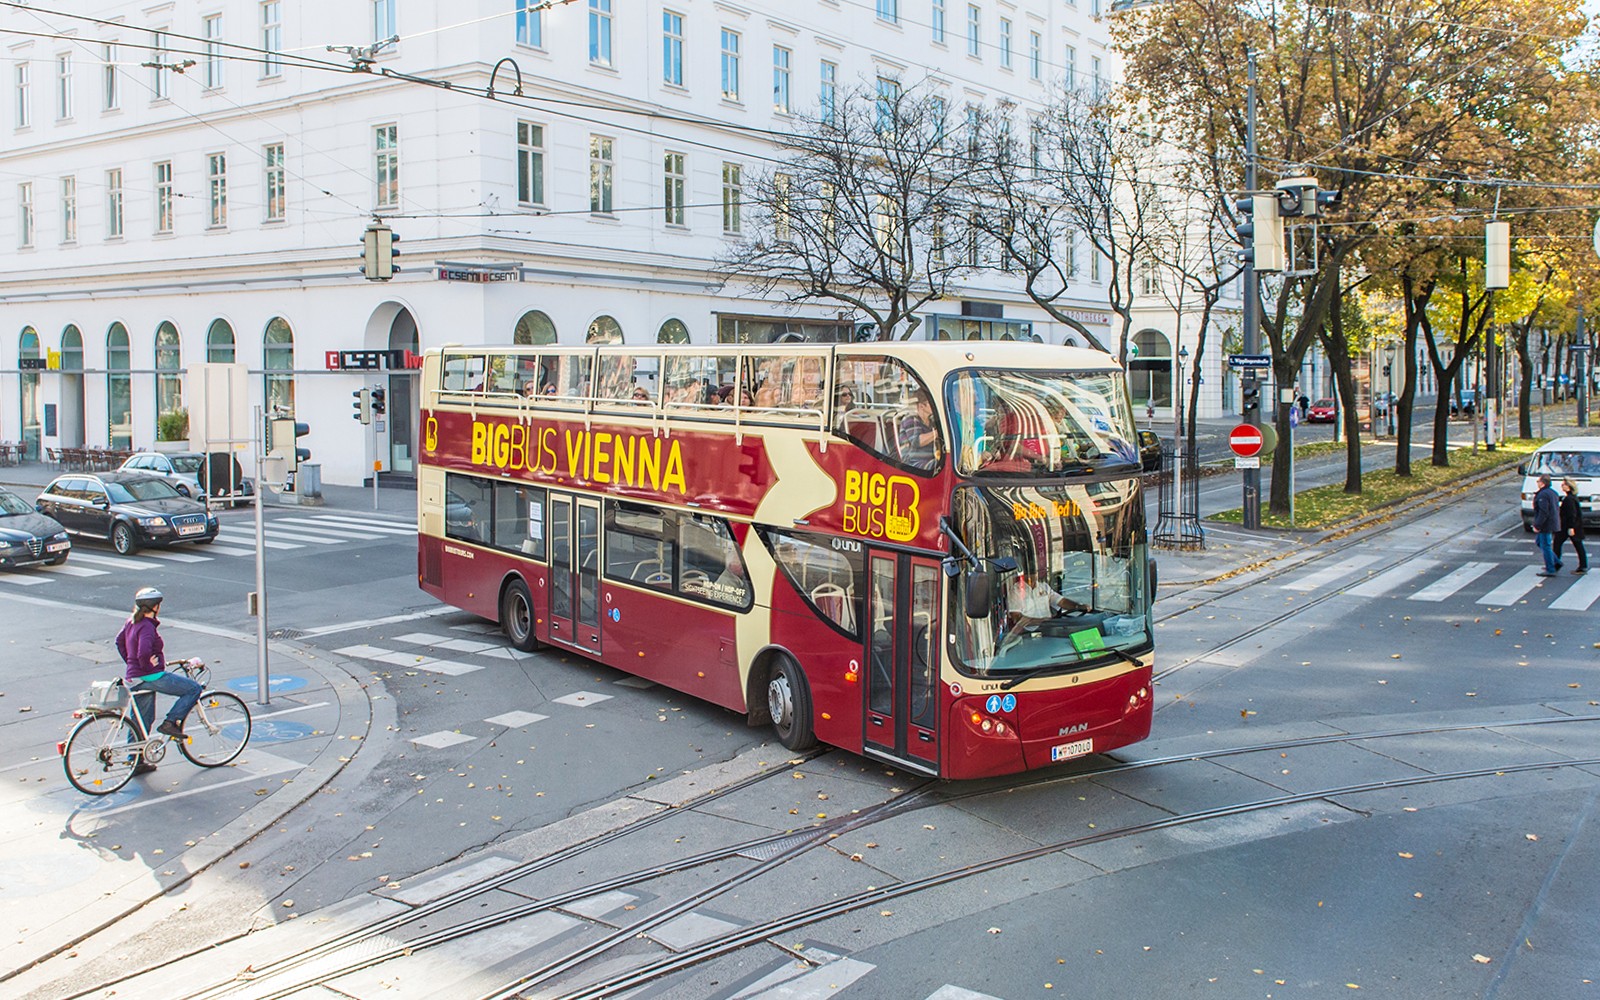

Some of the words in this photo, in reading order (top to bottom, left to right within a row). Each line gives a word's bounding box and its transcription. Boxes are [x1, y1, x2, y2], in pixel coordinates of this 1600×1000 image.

[565, 429, 687, 495] VIENNA
[845, 469, 886, 506] BIG
[843, 503, 884, 537] BUS
[1029, 502, 1046, 519] Bus
[1058, 722, 1089, 737] MAN
